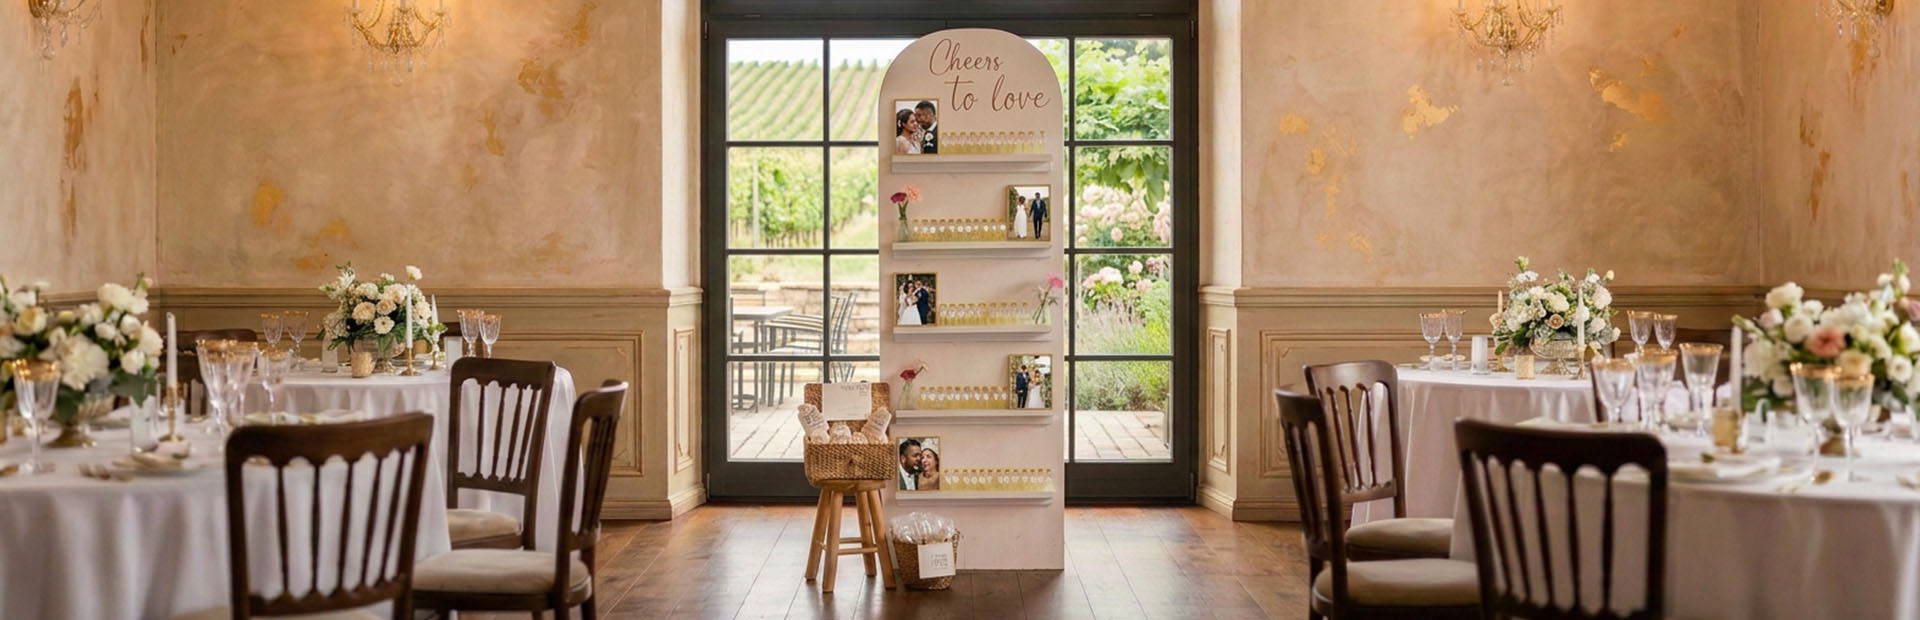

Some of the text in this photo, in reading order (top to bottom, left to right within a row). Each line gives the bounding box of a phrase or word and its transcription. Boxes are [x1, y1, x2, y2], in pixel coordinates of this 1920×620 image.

[929, 38, 1003, 76] Cheers
[944, 74, 1050, 112] to love
